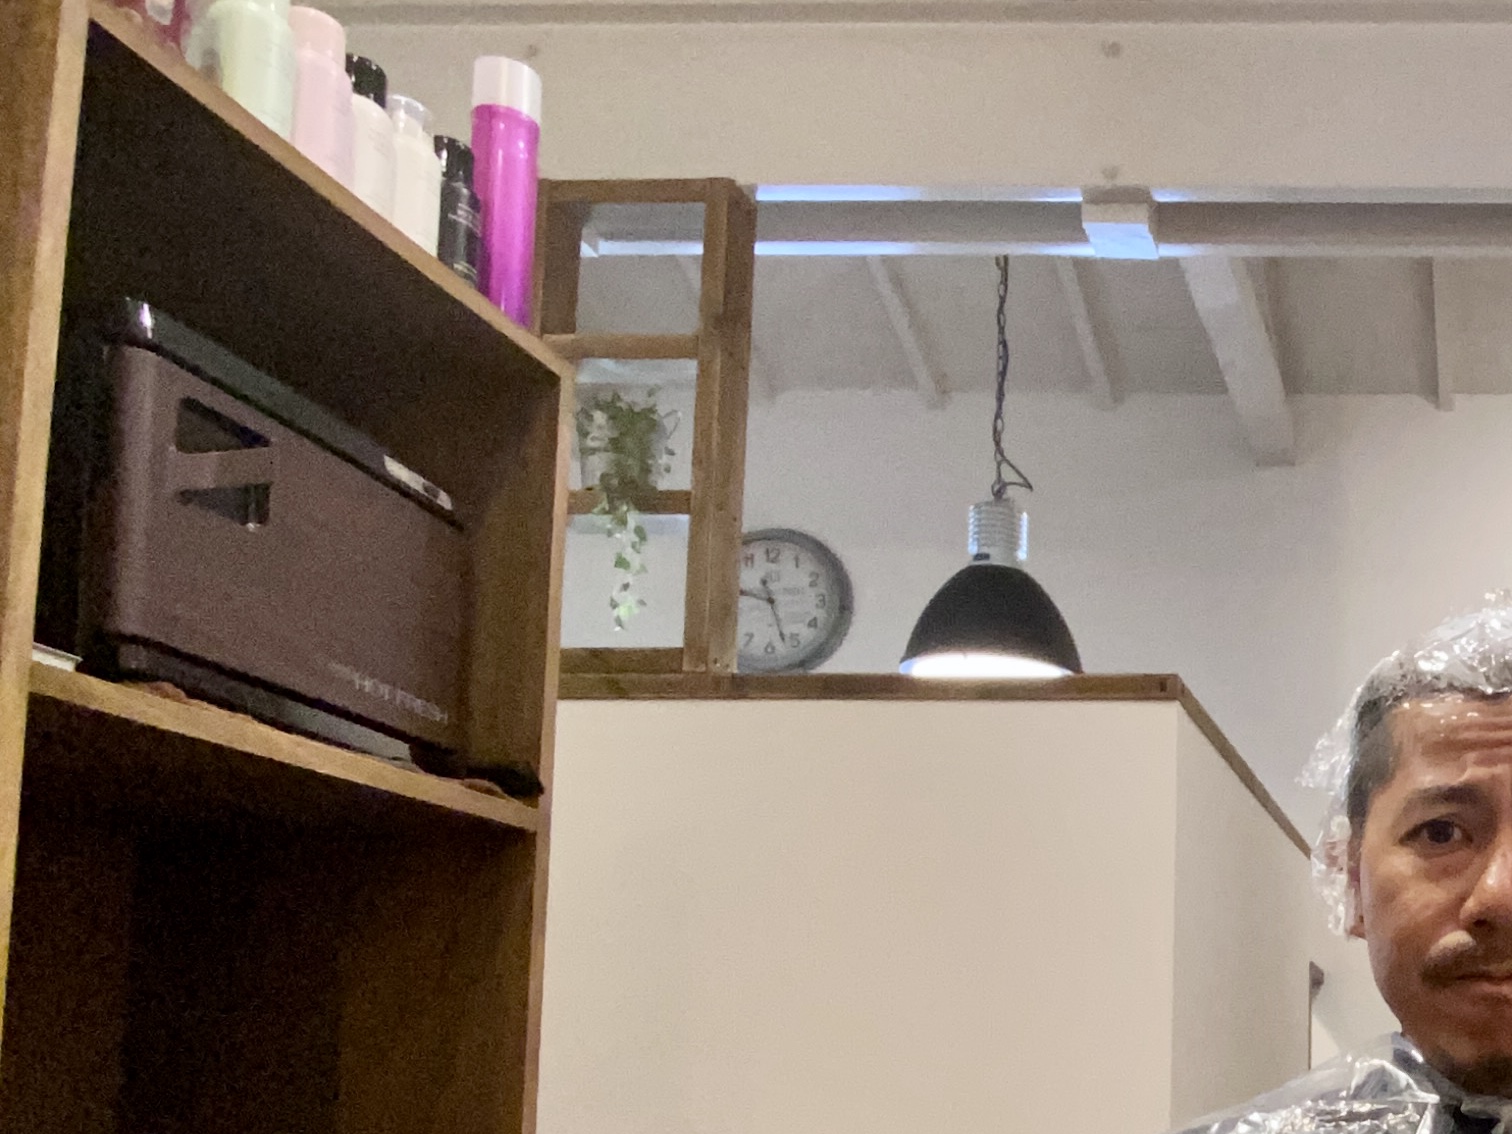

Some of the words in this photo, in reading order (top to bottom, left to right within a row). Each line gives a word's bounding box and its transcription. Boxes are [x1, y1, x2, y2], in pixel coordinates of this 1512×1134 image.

[765, 547, 780, 564] 12
[808, 571, 820, 588] 2
[814, 593, 826, 610] 3
[806, 616, 818, 630] 4
[764, 640, 776, 655] 6
[788, 632, 800, 649] 5
